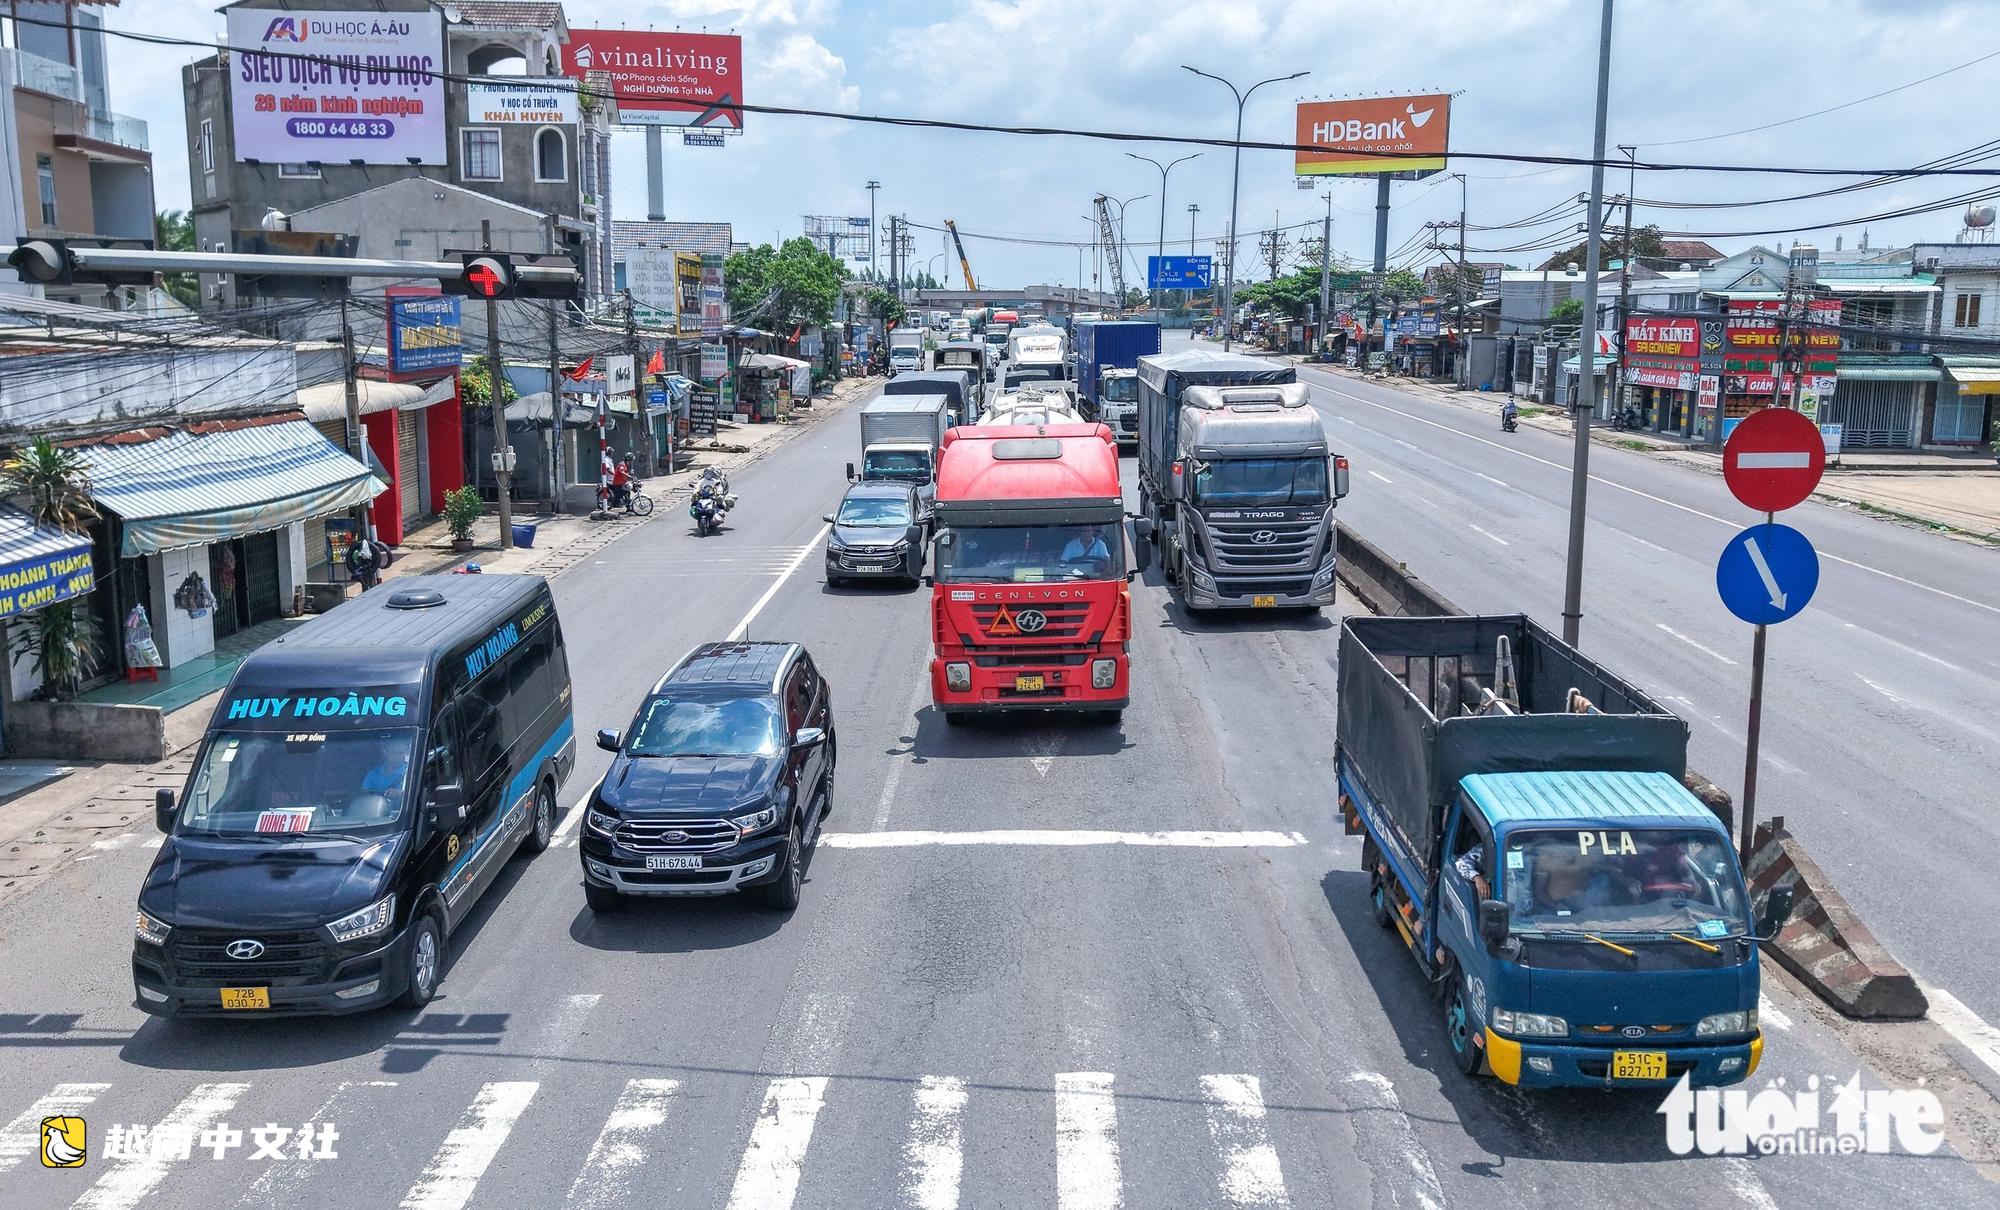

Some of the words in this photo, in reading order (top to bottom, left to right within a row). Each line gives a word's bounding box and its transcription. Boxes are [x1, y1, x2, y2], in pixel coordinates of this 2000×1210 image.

[312, 22, 332, 35] DU
[335, 22, 366, 36] HỌC
[370, 20, 410, 36] Á-ÂU
[600, 46, 728, 75] vinaliving
[241, 46, 283, 84] SIÊU
[288, 53, 331, 90] DỊCH
[337, 55, 361, 92] VỤ
[367, 55, 390, 86] DU
[397, 56, 433, 92] HỌC
[629, 73, 655, 83] Phong
[656, 73, 676, 82] cách
[677, 74, 698, 84] Sống
[623, 84, 645, 93] NGHỈ
[646, 84, 679, 94] DƯỠNG
[682, 87, 693, 95] Tại
[696, 86, 713, 95] NHÀ
[254, 94, 276, 112] 26
[280, 94, 317, 113] năm
[321, 96, 358, 113] kinh
[361, 97, 424, 118] nghiệm
[501, 98, 506, 108] Y
[507, 98, 521, 110] HỌC
[294, 122, 326, 135] 1800
[329, 123, 347, 136] 64
[350, 123, 367, 136] 68
[370, 123, 387, 136] 33
[1312, 118, 1406, 143] HDBank
[1394, 143, 1413, 151] nhất
[1628, 319, 1657, 341] MẮT
[1658, 320, 1696, 342] KÍNH
[1732, 331, 1765, 345] SÀI
[1810, 335, 1840, 346] NEW
[1701, 376, 1717, 391] MẮT
[1749, 378, 1774, 391] GIẢM
[1699, 392, 1716, 406] KÍNH
[0, 567, 48, 592] HOÀNH
[50, 553, 92, 577] THÁNH
[18, 584, 57, 609] CANH
[978, 590, 1084, 599] GENLVON
[465, 645, 488, 680] HUY
[485, 624, 519, 665] HOÀNG
[228, 698, 290, 719] HUY
[294, 691, 407, 717] HOÀNG
[286, 734, 295, 742] XE
[666, 833, 683, 841] Ford
[1578, 831, 1638, 856] PLA
[647, 857, 701, 868] 51H-678.44
[233, 989, 255, 998] 72B
[227, 998, 265, 1008] 030.72
[1626, 1027, 1643, 1036] KIA
[1628, 1053, 1652, 1065] 51C
[1619, 1066, 1661, 1078] 827.17
